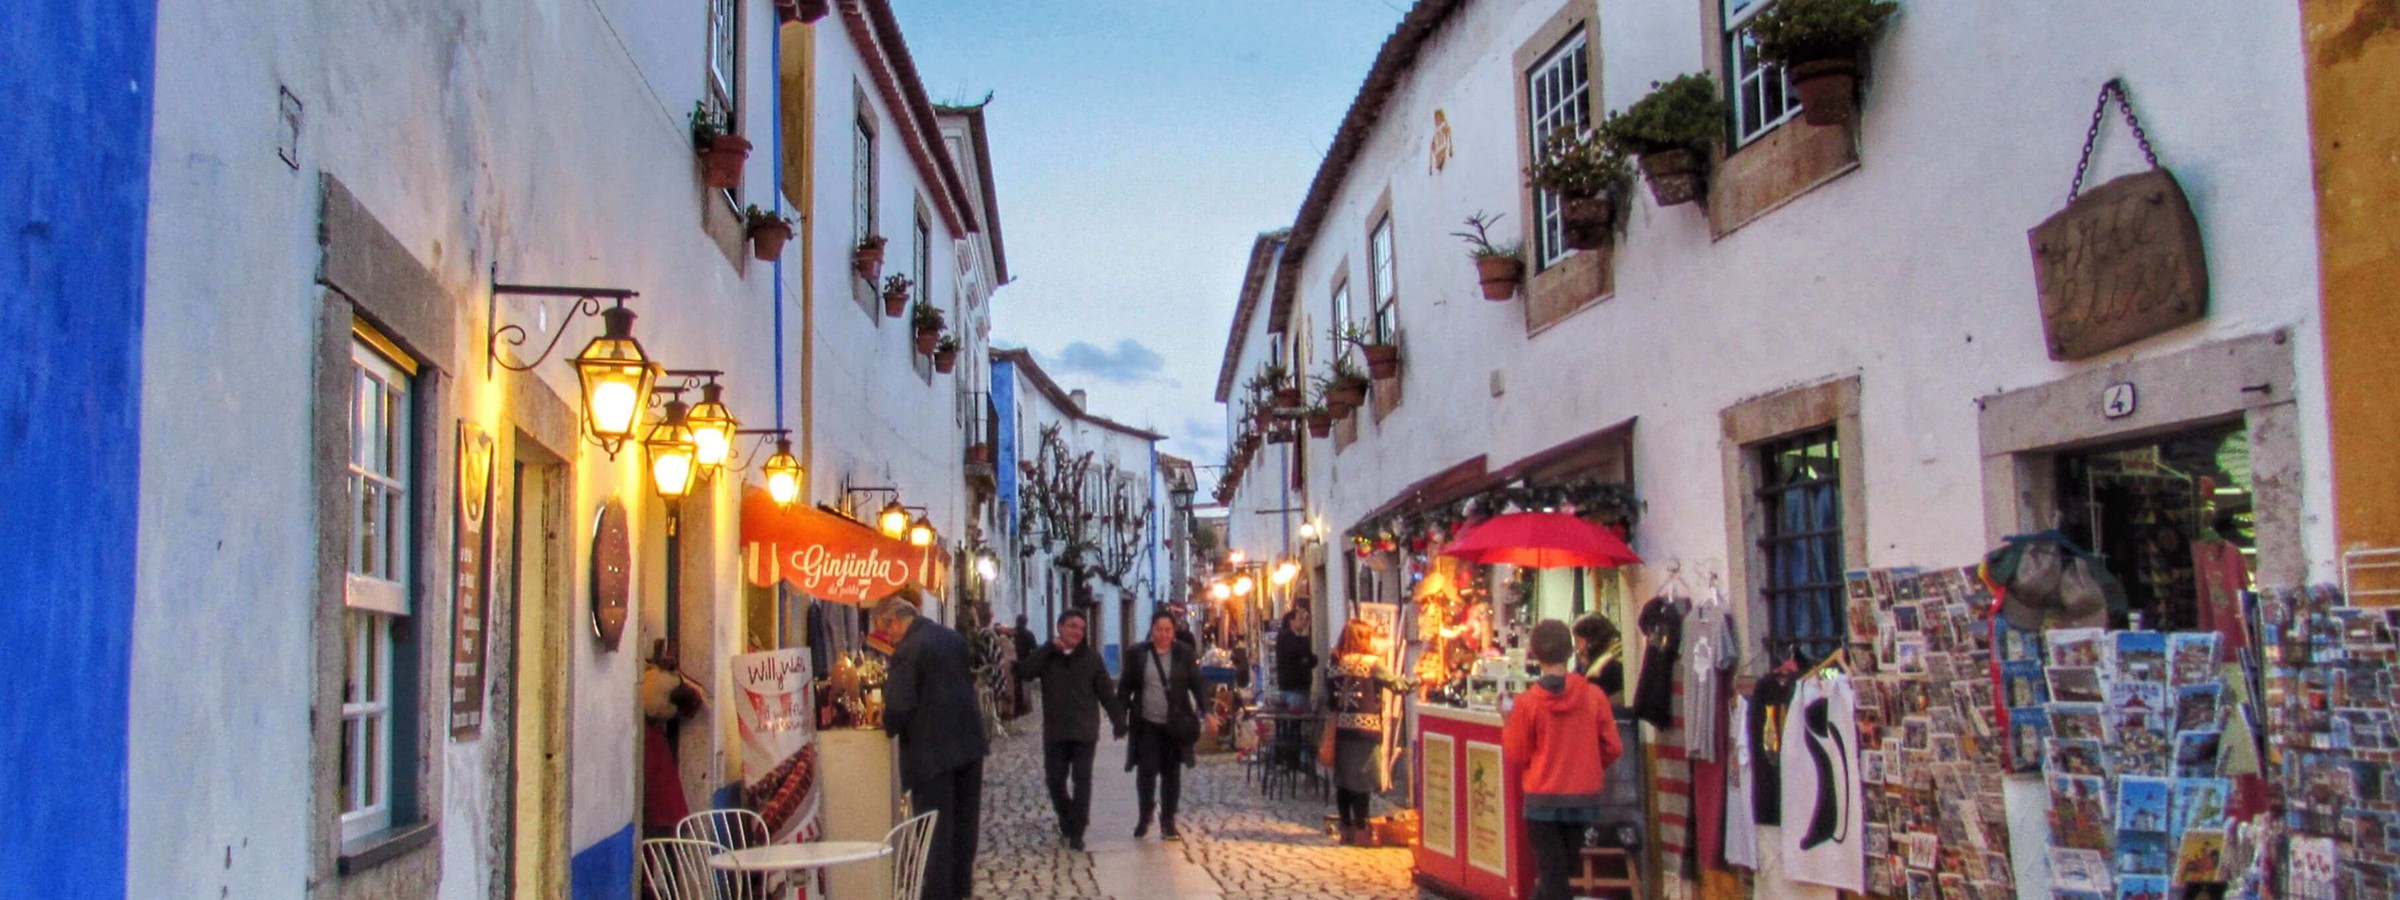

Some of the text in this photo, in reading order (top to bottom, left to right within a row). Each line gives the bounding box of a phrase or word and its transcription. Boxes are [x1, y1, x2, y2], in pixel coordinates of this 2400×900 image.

[2109, 386, 2126, 413] 4
[791, 544, 909, 589] Ginjinha
[858, 578, 872, 600] 7
[748, 656, 784, 691] Willy
